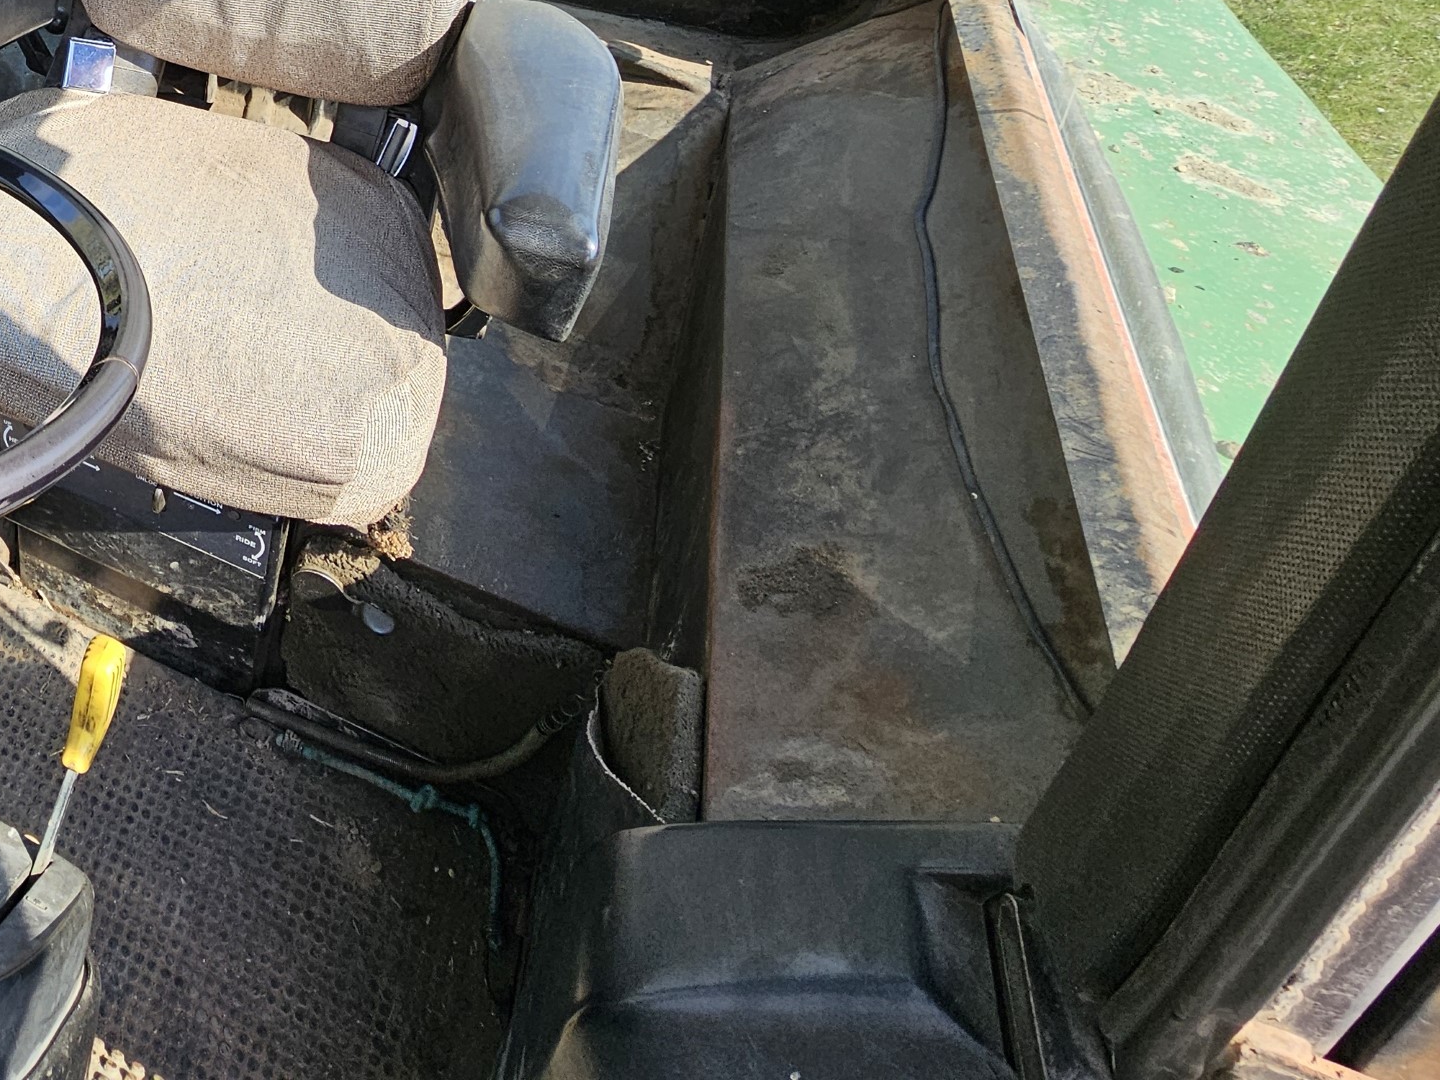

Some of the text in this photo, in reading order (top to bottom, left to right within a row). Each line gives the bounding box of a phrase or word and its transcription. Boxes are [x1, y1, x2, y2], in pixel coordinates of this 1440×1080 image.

[135, 474, 157, 487] UNLOC
[248, 524, 266, 536] FIRM
[235, 534, 256, 548] RIDE
[242, 555, 262, 567] SOFT
